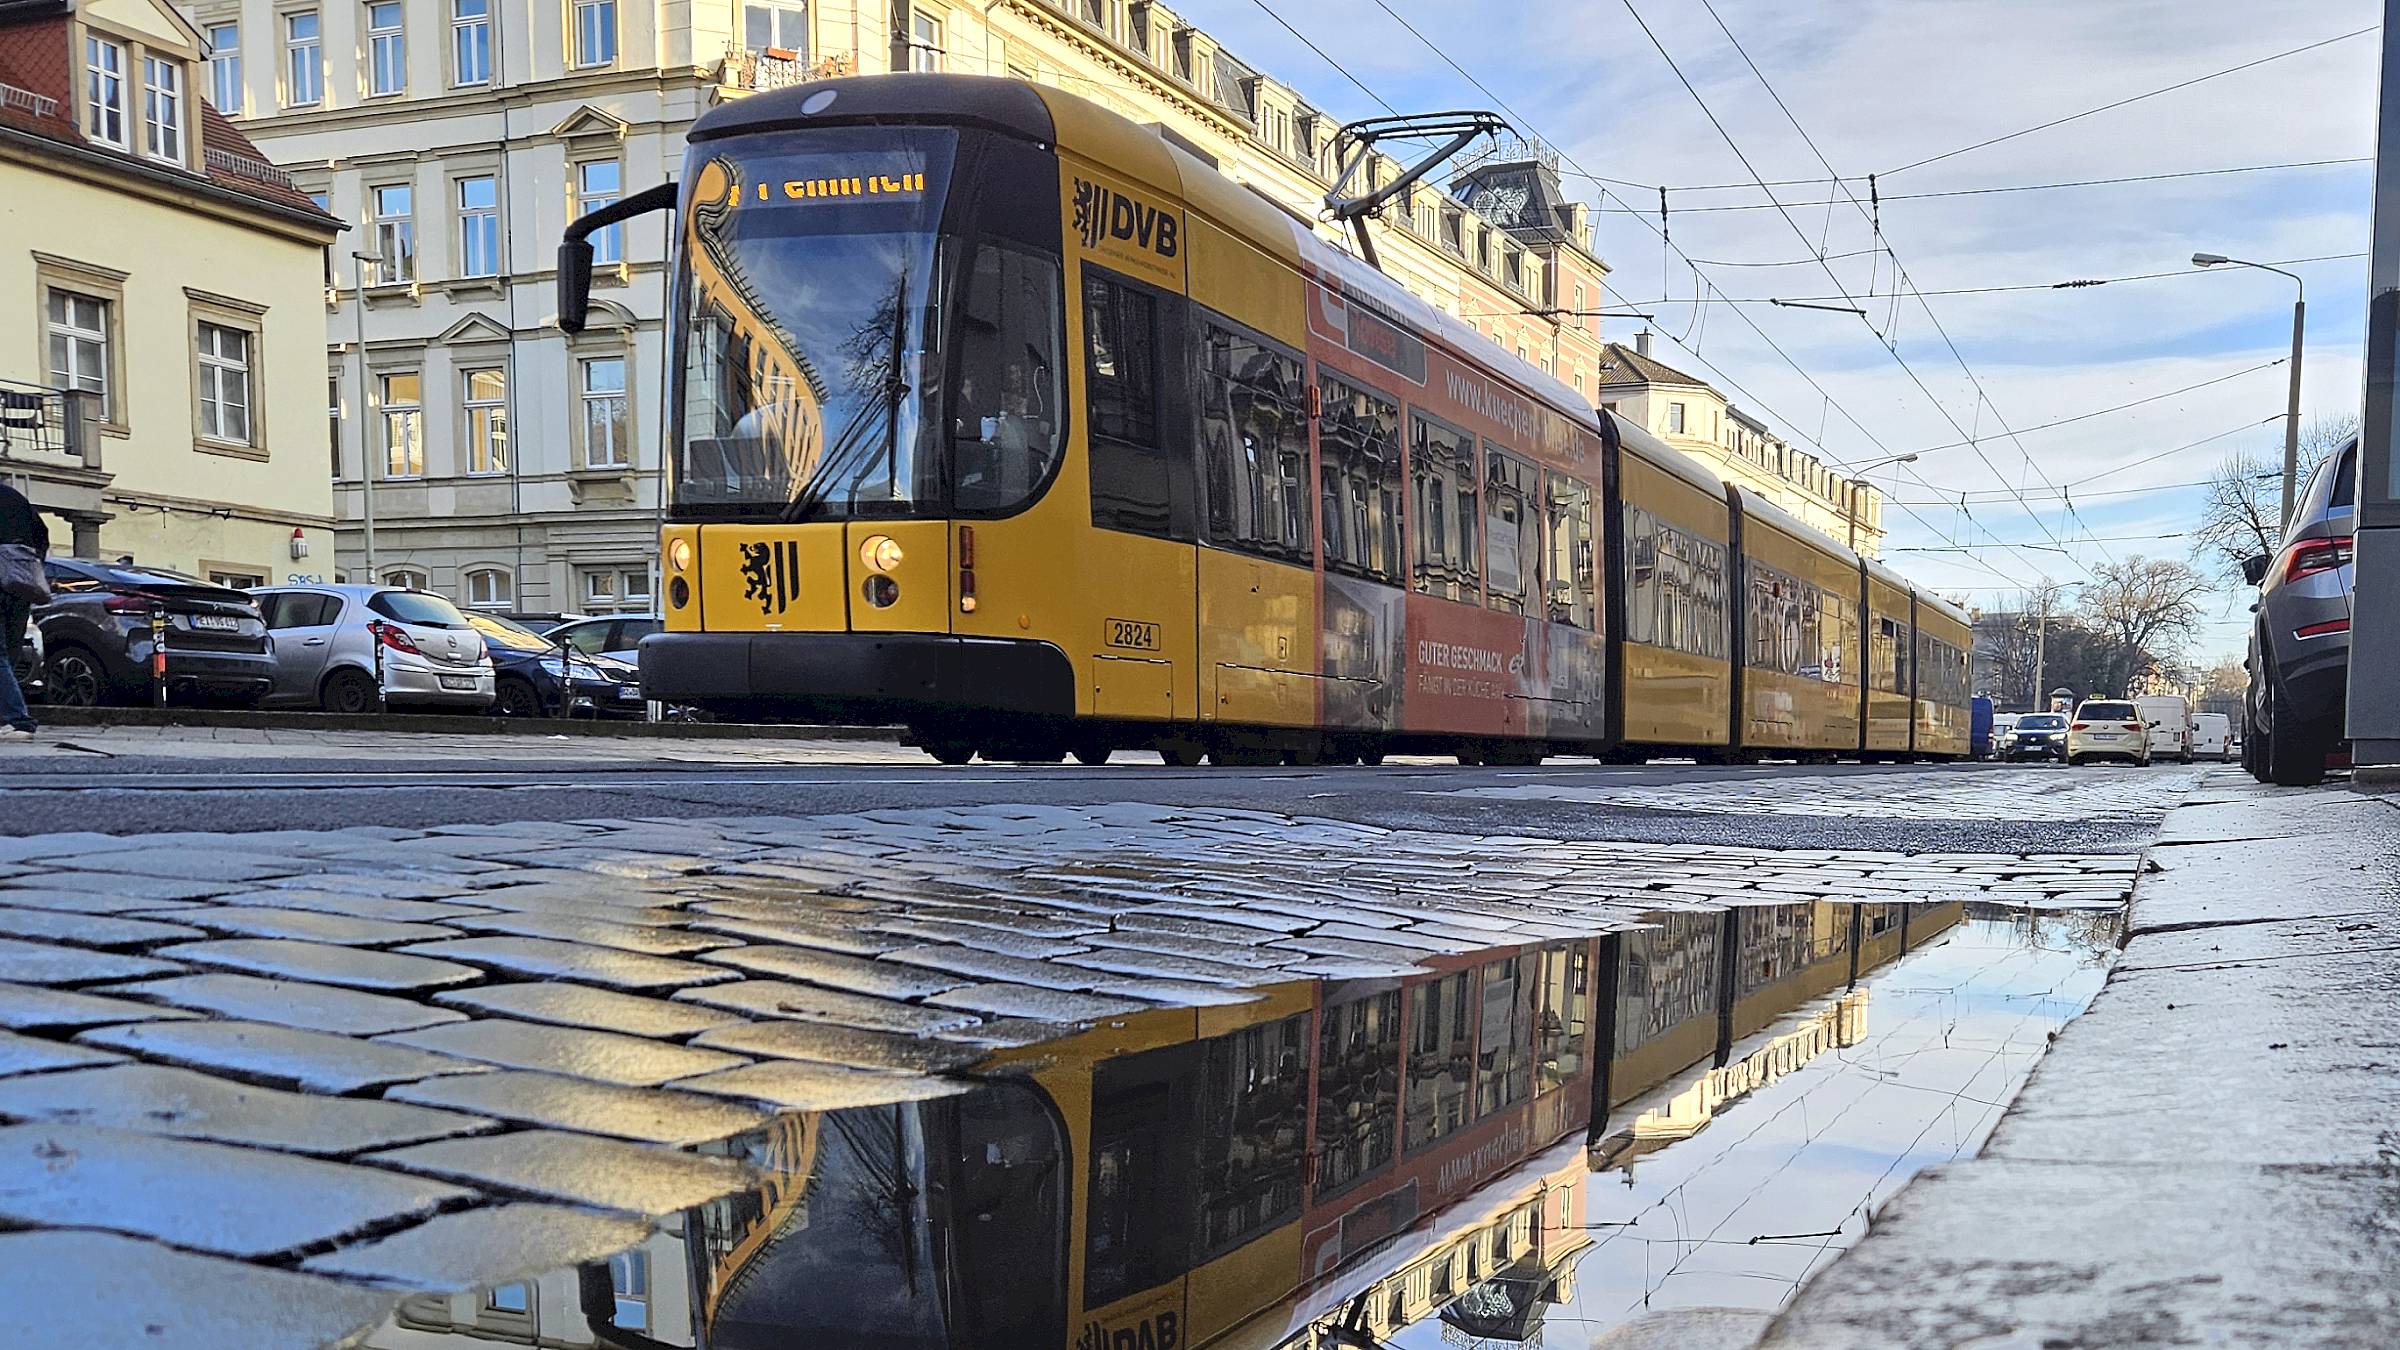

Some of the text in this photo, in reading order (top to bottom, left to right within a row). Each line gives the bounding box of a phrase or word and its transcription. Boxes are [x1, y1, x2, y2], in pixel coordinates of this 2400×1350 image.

[1111, 192, 1177, 258] DVB
[1114, 622, 1152, 647] 2824
[1418, 640, 1504, 674] GUTER GESCHMACK
